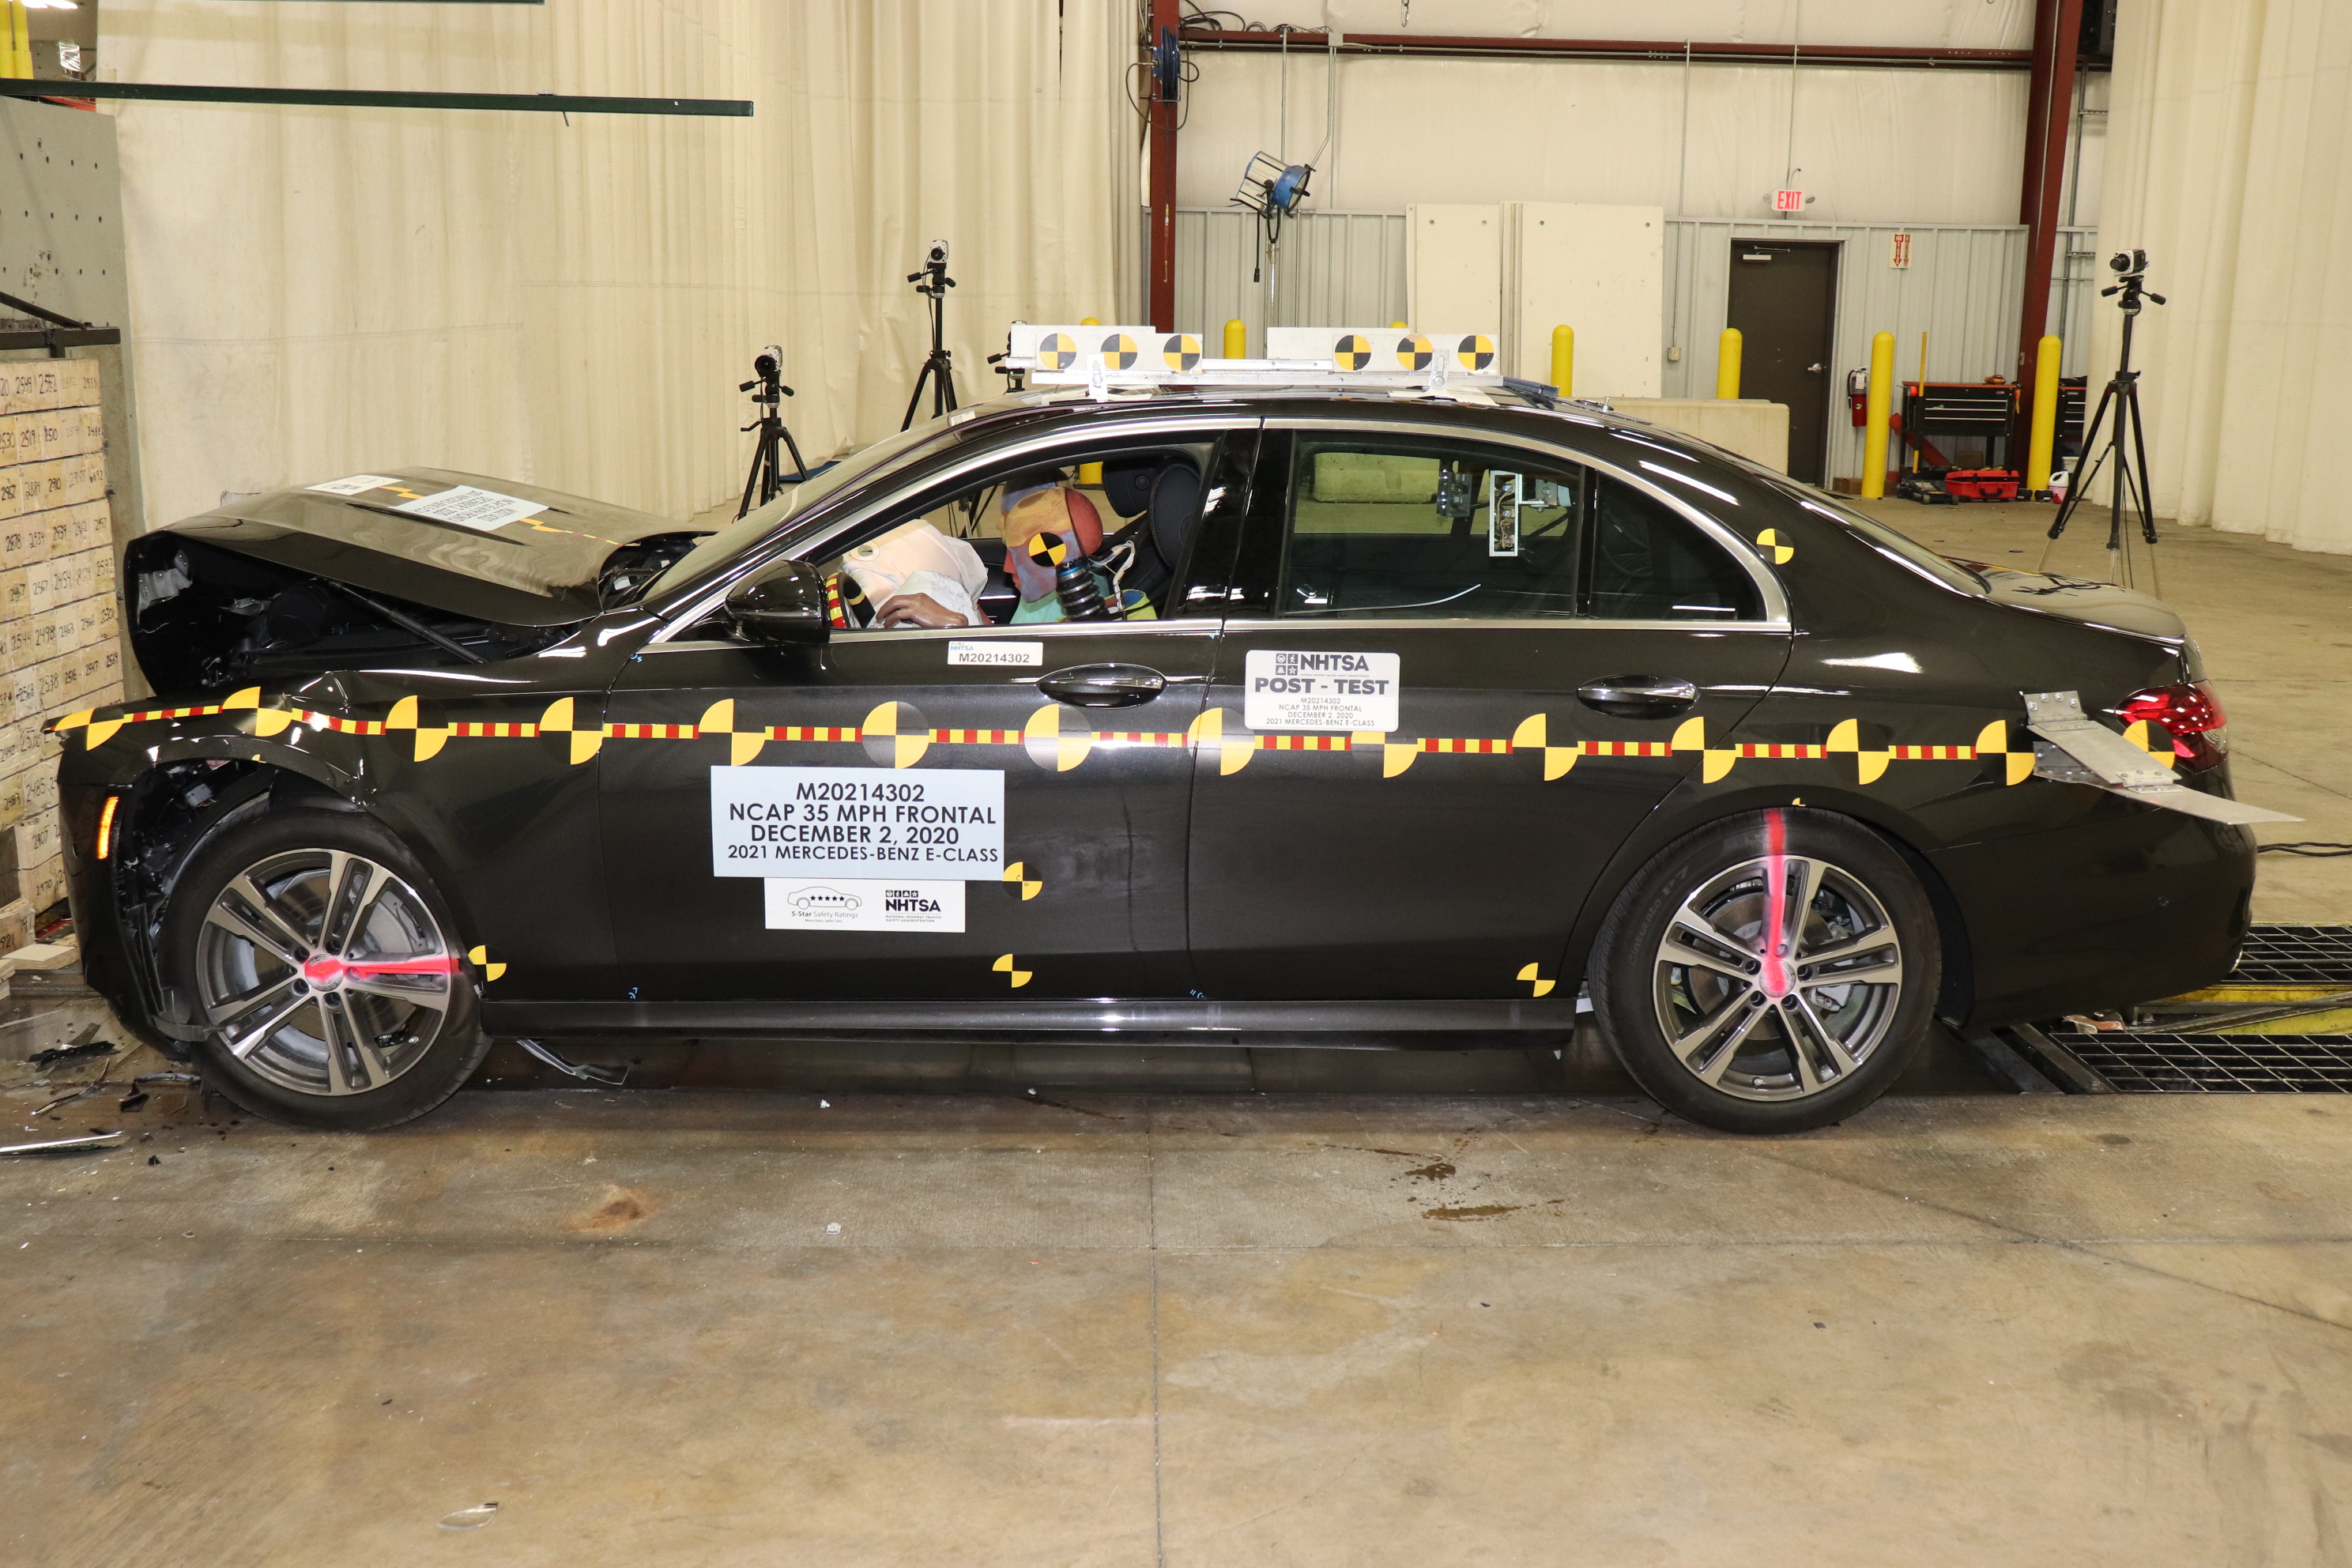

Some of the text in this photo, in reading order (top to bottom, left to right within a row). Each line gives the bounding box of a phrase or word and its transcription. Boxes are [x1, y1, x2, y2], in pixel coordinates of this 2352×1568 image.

[1777, 190, 1802, 210] EXIT
[33, 579, 48, 595] 2567
[55, 569, 72, 591] 2454
[59, 623, 75, 638] 2463
[959, 653, 1030, 663] M20214302
[1300, 654, 1370, 672] NHTSA
[1255, 677, 1316, 694] POST
[1333, 679, 1389, 695] TEST
[25, 777, 46, 803] 2485
[796, 782, 925, 802] M20214302
[729, 803, 997, 824] NCAP 35 MPH FRONTAL
[751, 824, 959, 846] DECEMBER 2, 2020
[728, 844, 998, 862] 2021 MERCEDES-BENZ E-CLASS
[885, 899, 941, 912] NHTSA
